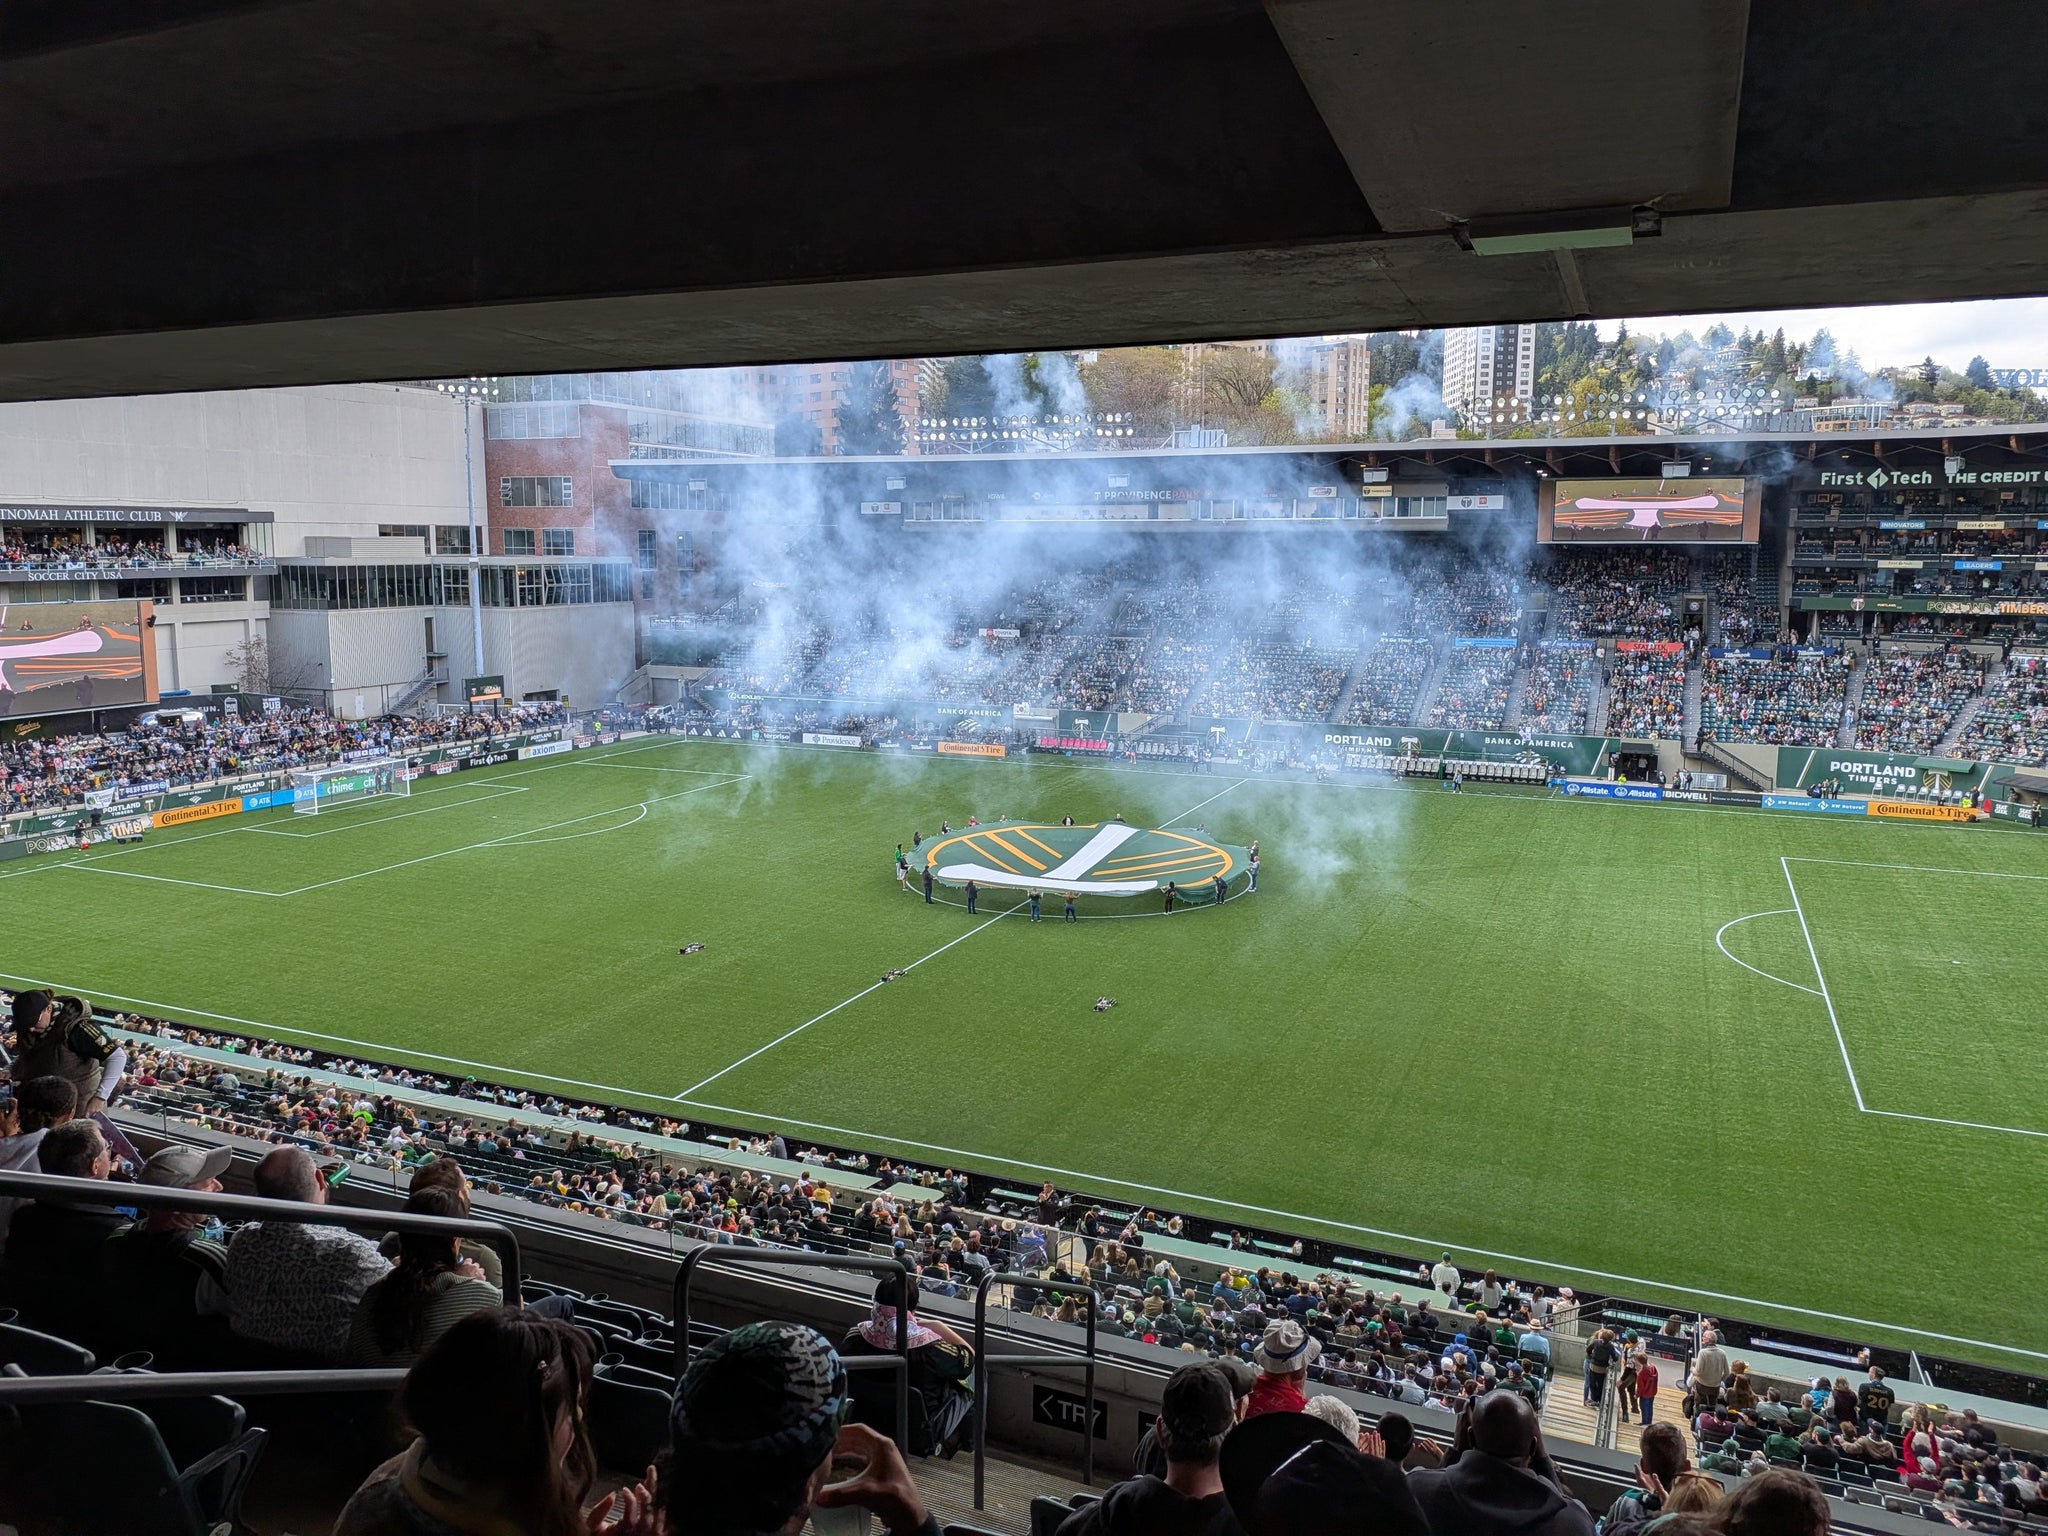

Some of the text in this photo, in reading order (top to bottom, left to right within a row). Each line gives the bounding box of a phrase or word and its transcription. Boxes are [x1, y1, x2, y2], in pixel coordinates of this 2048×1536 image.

[1993, 368, 2048, 388] VOL
[1821, 470, 1933, 486] First Tech
[1946, 472, 1977, 484] THE
[1980, 471, 2040, 483] CREDIT
[1104, 490, 1201, 500] PROVIDENCE PARK
[63, 510, 124, 521] ATHLETIC
[129, 511, 162, 521] CLUB
[1881, 521, 1924, 529] INNOVATORS
[28, 571, 123, 581] SOCCER CITY USA
[937, 707, 957, 715] BANK
[968, 709, 1002, 717] AMERICA
[763, 731, 790, 740] terprise
[822, 735, 856, 746] Providence
[1324, 734, 1392, 747] PORTLAND
[944, 743, 1001, 754] Continental Tire
[1484, 736, 1574, 749] BANK OF AMERICA
[446, 745, 472, 754] PORTLAND
[532, 744, 556, 756] axiom
[470, 753, 508, 767] First Tech
[395, 766, 425, 778] DISOUNT
[1830, 761, 1916, 778] PORTLAND
[1848, 774, 1897, 785] TIMBERS
[232, 780, 266, 792] PORTLAND
[327, 782, 354, 795] chime
[1580, 785, 1609, 795] Allstate
[303, 789, 315, 797] AT&
[1627, 789, 1658, 798] Allstate
[1665, 790, 1708, 801] BIDWELL
[258, 796, 271, 805] AT&
[102, 801, 141, 814] PORTLAND
[161, 802, 237, 825] Continental Tire
[1877, 803, 1970, 818] Continental Tire
[26, 828, 102, 854] PORTND
[1867, 1394, 1889, 1410] 20
